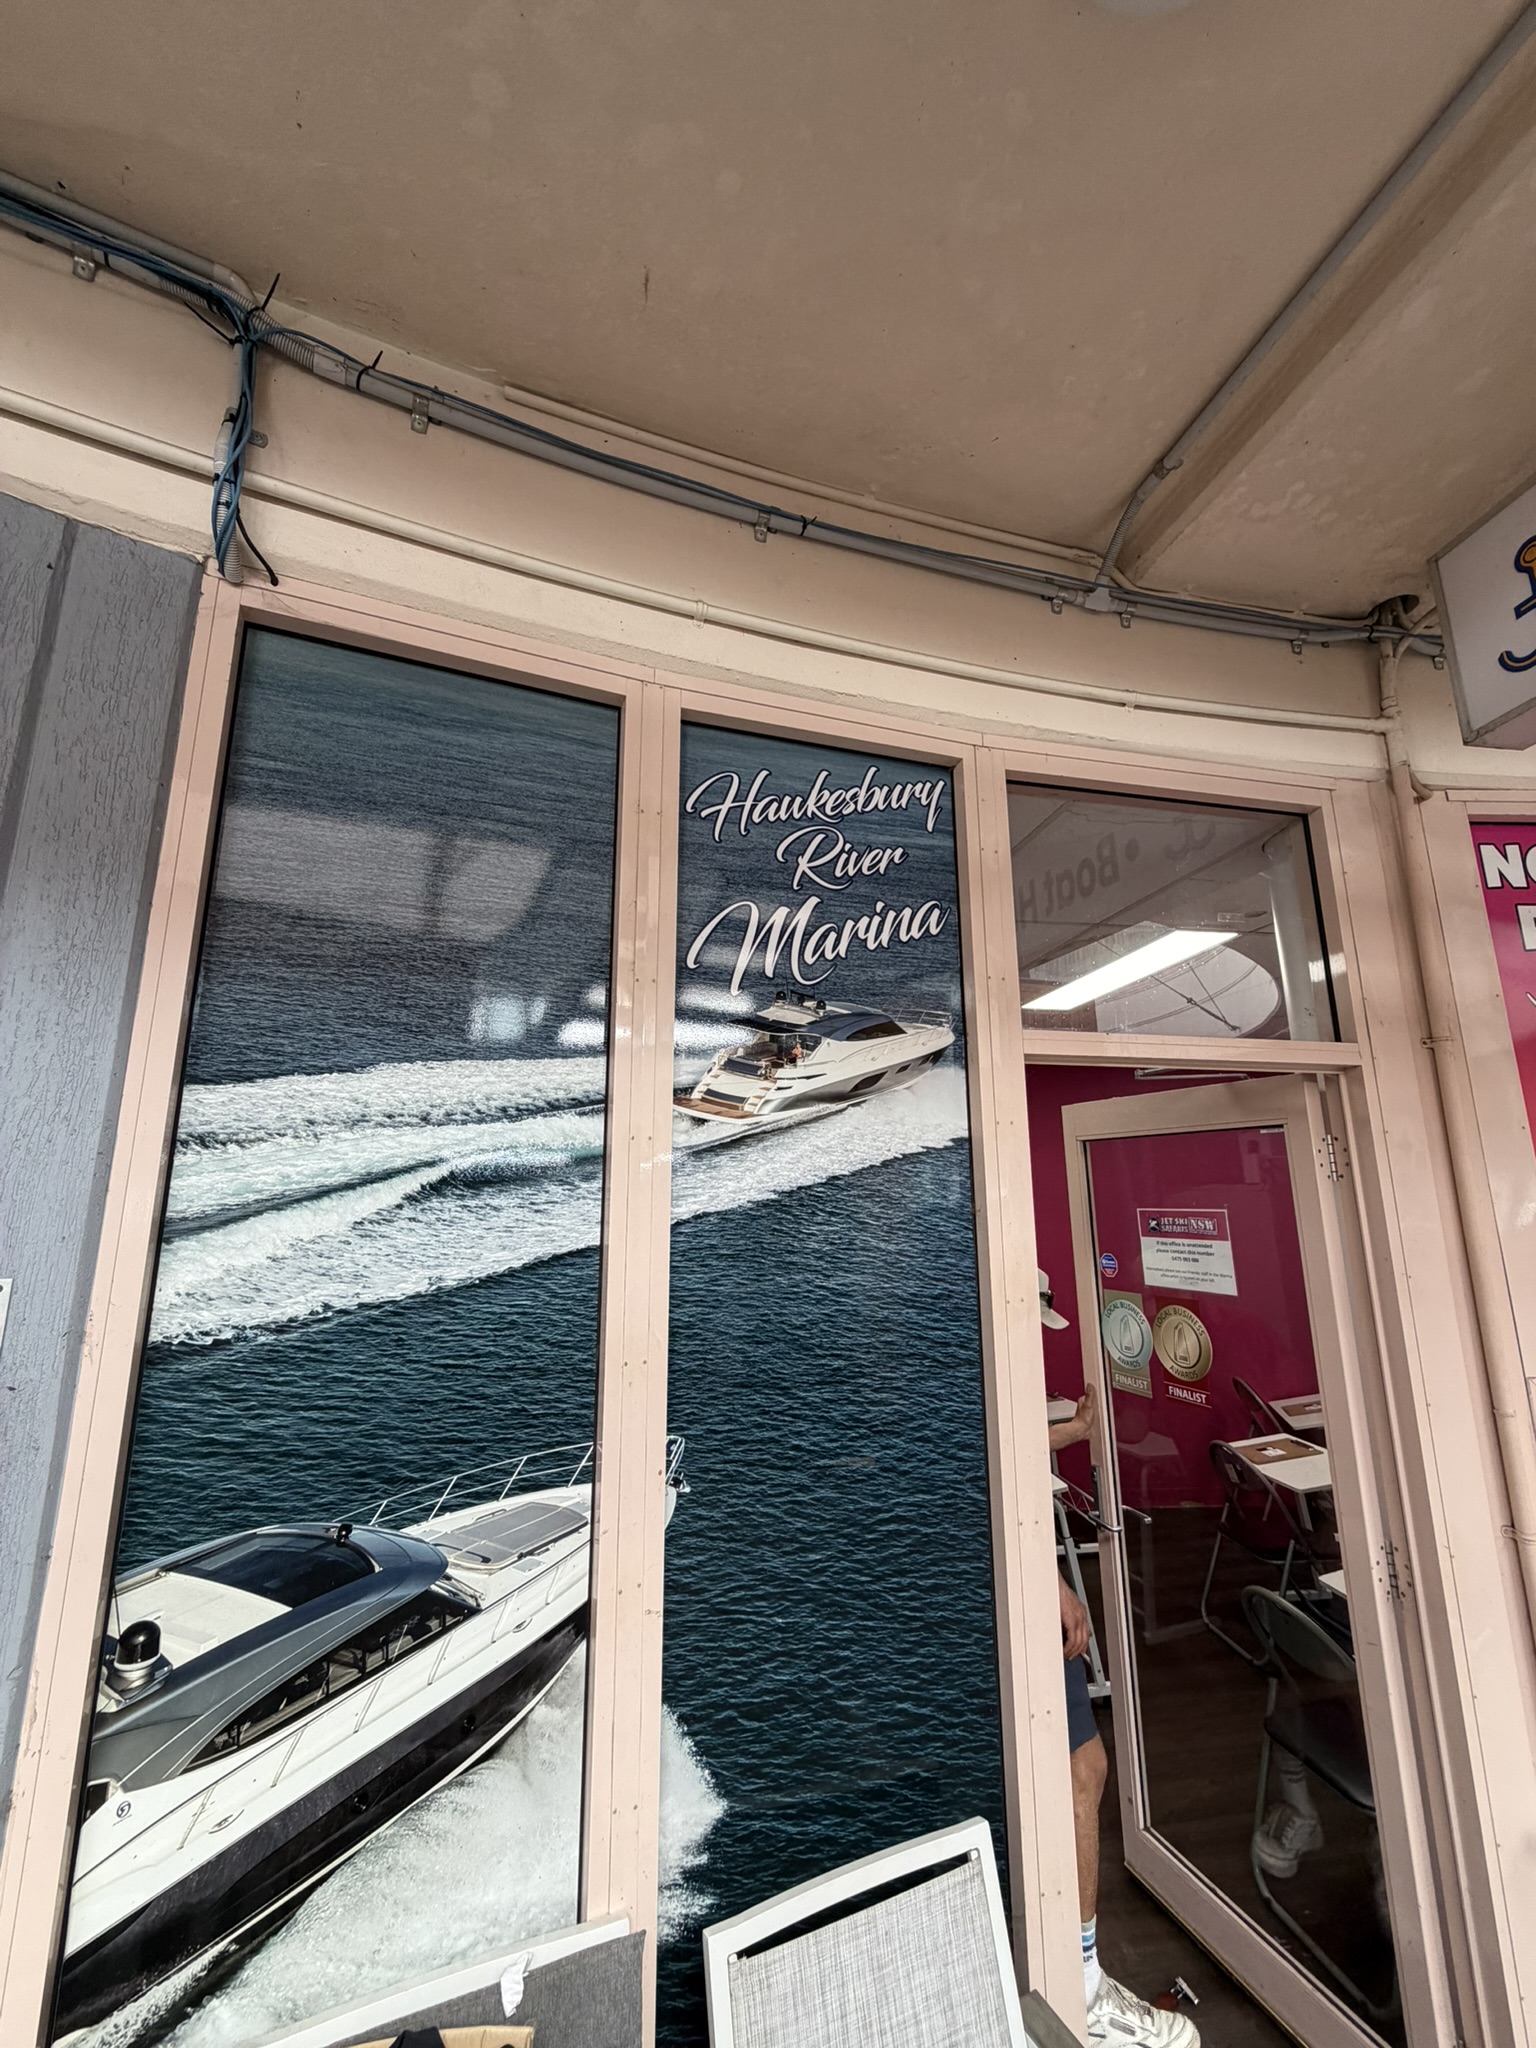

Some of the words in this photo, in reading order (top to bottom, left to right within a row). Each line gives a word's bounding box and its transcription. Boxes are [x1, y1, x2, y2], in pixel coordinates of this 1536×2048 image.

[685, 766, 945, 842] Hawkesbury
[775, 825, 908, 890] River
[1478, 842, 1536, 890] N
[685, 895, 950, 996] Marina
[1161, 1217, 1173, 1225] JET
[1174, 1217, 1188, 1225] SKI
[1190, 1218, 1215, 1231] NSW
[1105, 1301, 1120, 1319] LOCAL
[1120, 1301, 1146, 1325] BUSINESS
[1155, 1308, 1172, 1328] LOCAL
[1173, 1307, 1205, 1337] BUSINESS
[1117, 1355, 1141, 1368] AWARDS
[1169, 1365, 1199, 1380] AWARDS
[1115, 1374, 1148, 1390] FINALIST
[1168, 1386, 1206, 1404] FINALIST
